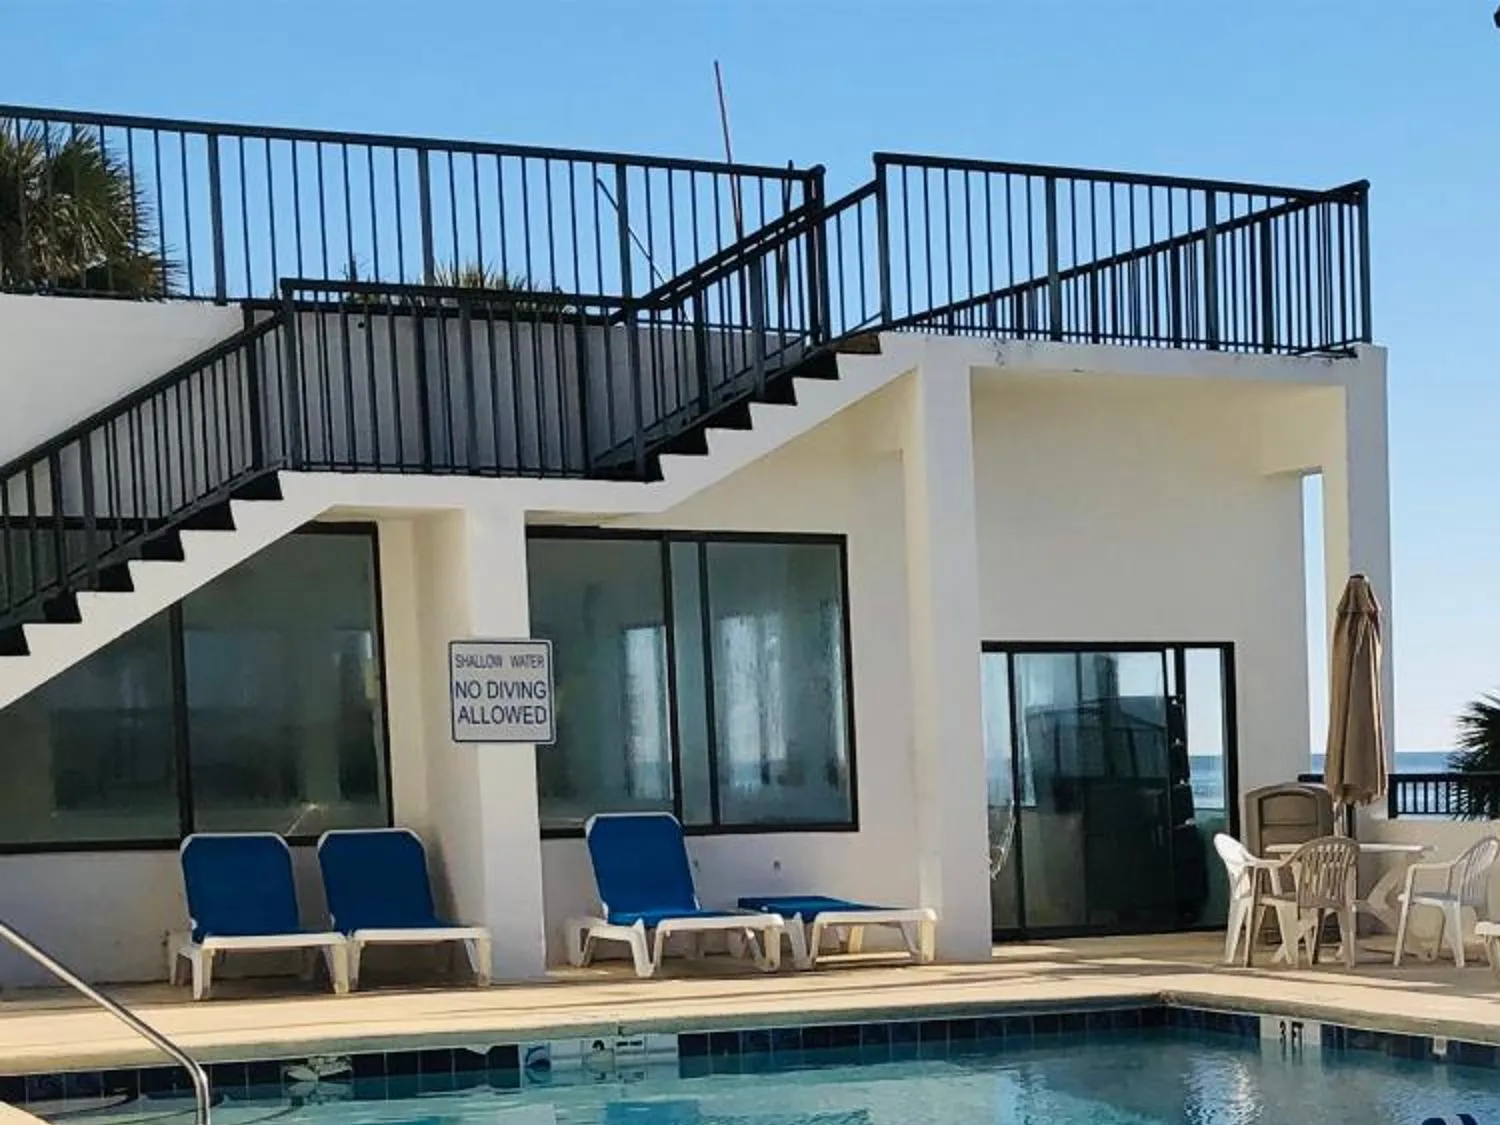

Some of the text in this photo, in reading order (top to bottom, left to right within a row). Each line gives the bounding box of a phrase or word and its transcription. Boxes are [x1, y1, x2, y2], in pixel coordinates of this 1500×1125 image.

[455, 654, 545, 669] SHALLOW WATER
[455, 681, 546, 699] NO DIVING
[457, 705, 547, 724] ALLOWED
